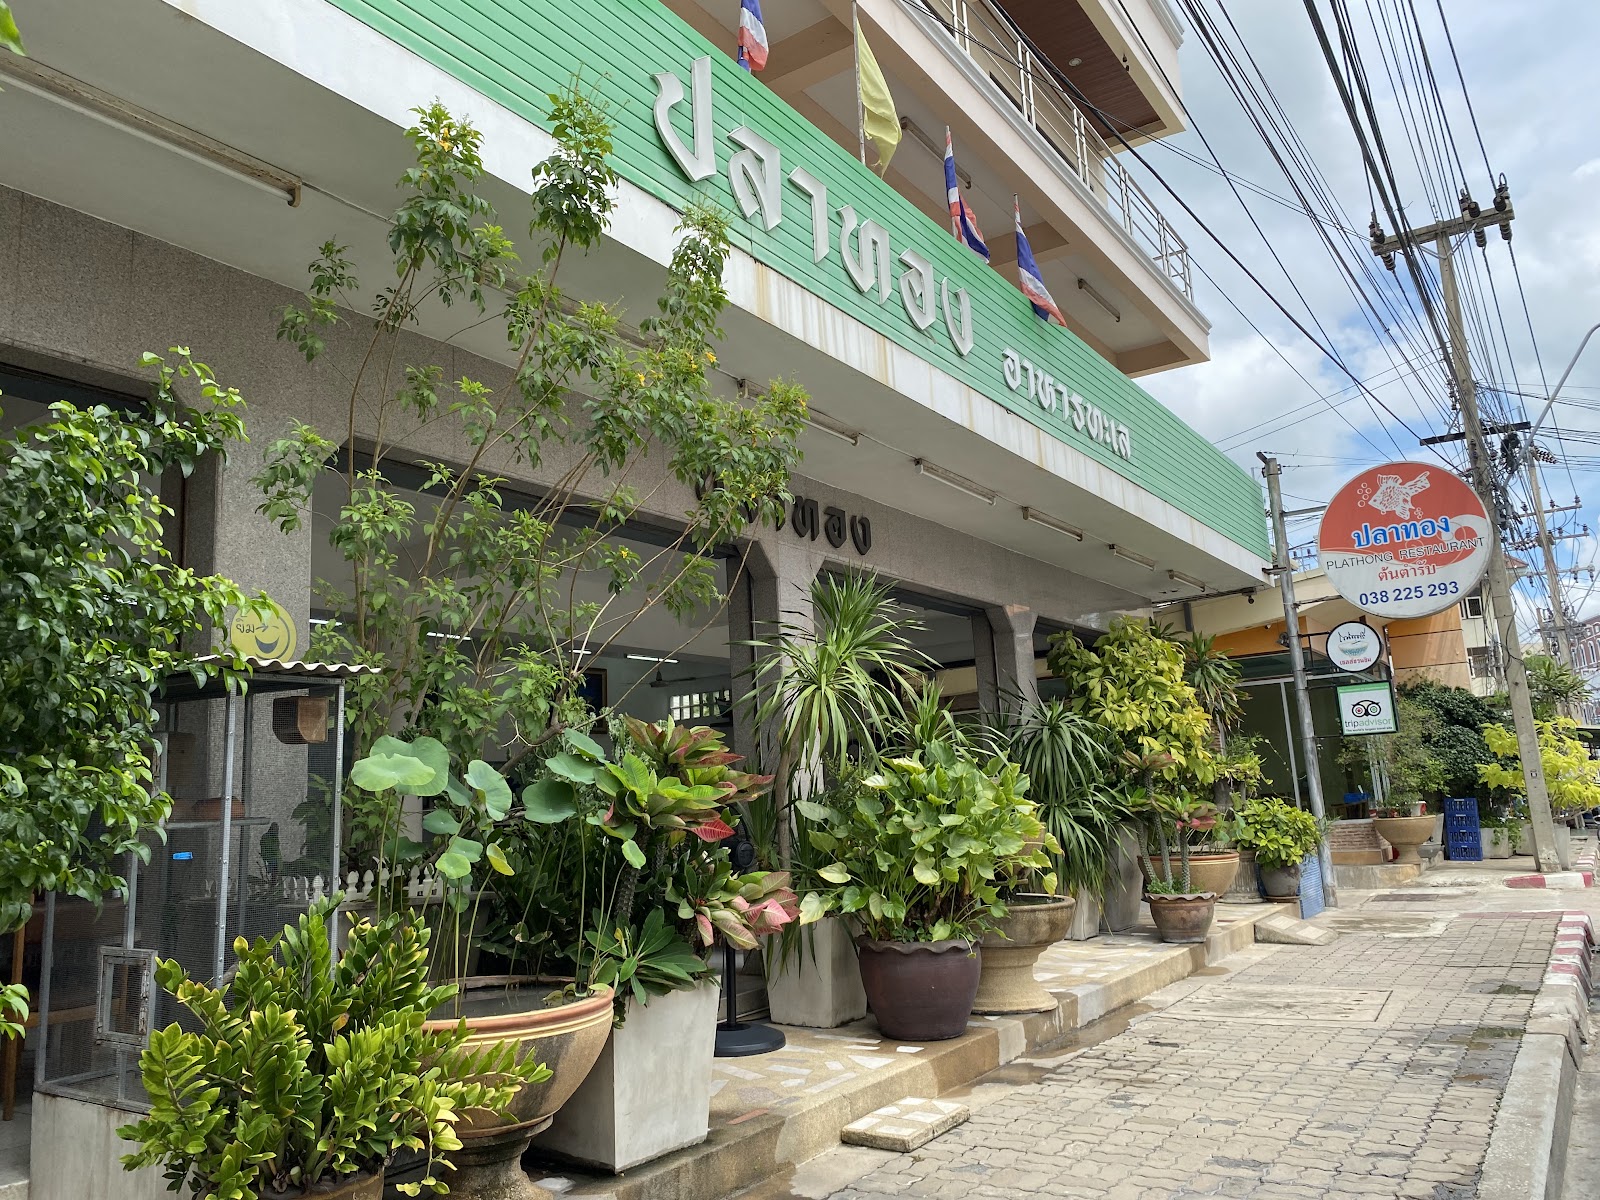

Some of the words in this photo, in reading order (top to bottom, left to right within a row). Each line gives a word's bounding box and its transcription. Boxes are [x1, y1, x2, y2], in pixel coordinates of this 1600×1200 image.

[651, 55, 974, 356] ปลาทอง
[1002, 347, 1131, 460] อาหารทะเล
[1351, 515, 1451, 549] ปลาทอง
[1326, 551, 1393, 571] PLATHONG
[1399, 537, 1485, 559] RESTAURANT
[1359, 586, 1389, 606] 038
[1393, 583, 1424, 602] 225
[1428, 581, 1459, 598] 293
[1344, 718, 1392, 729] tripadvisor
